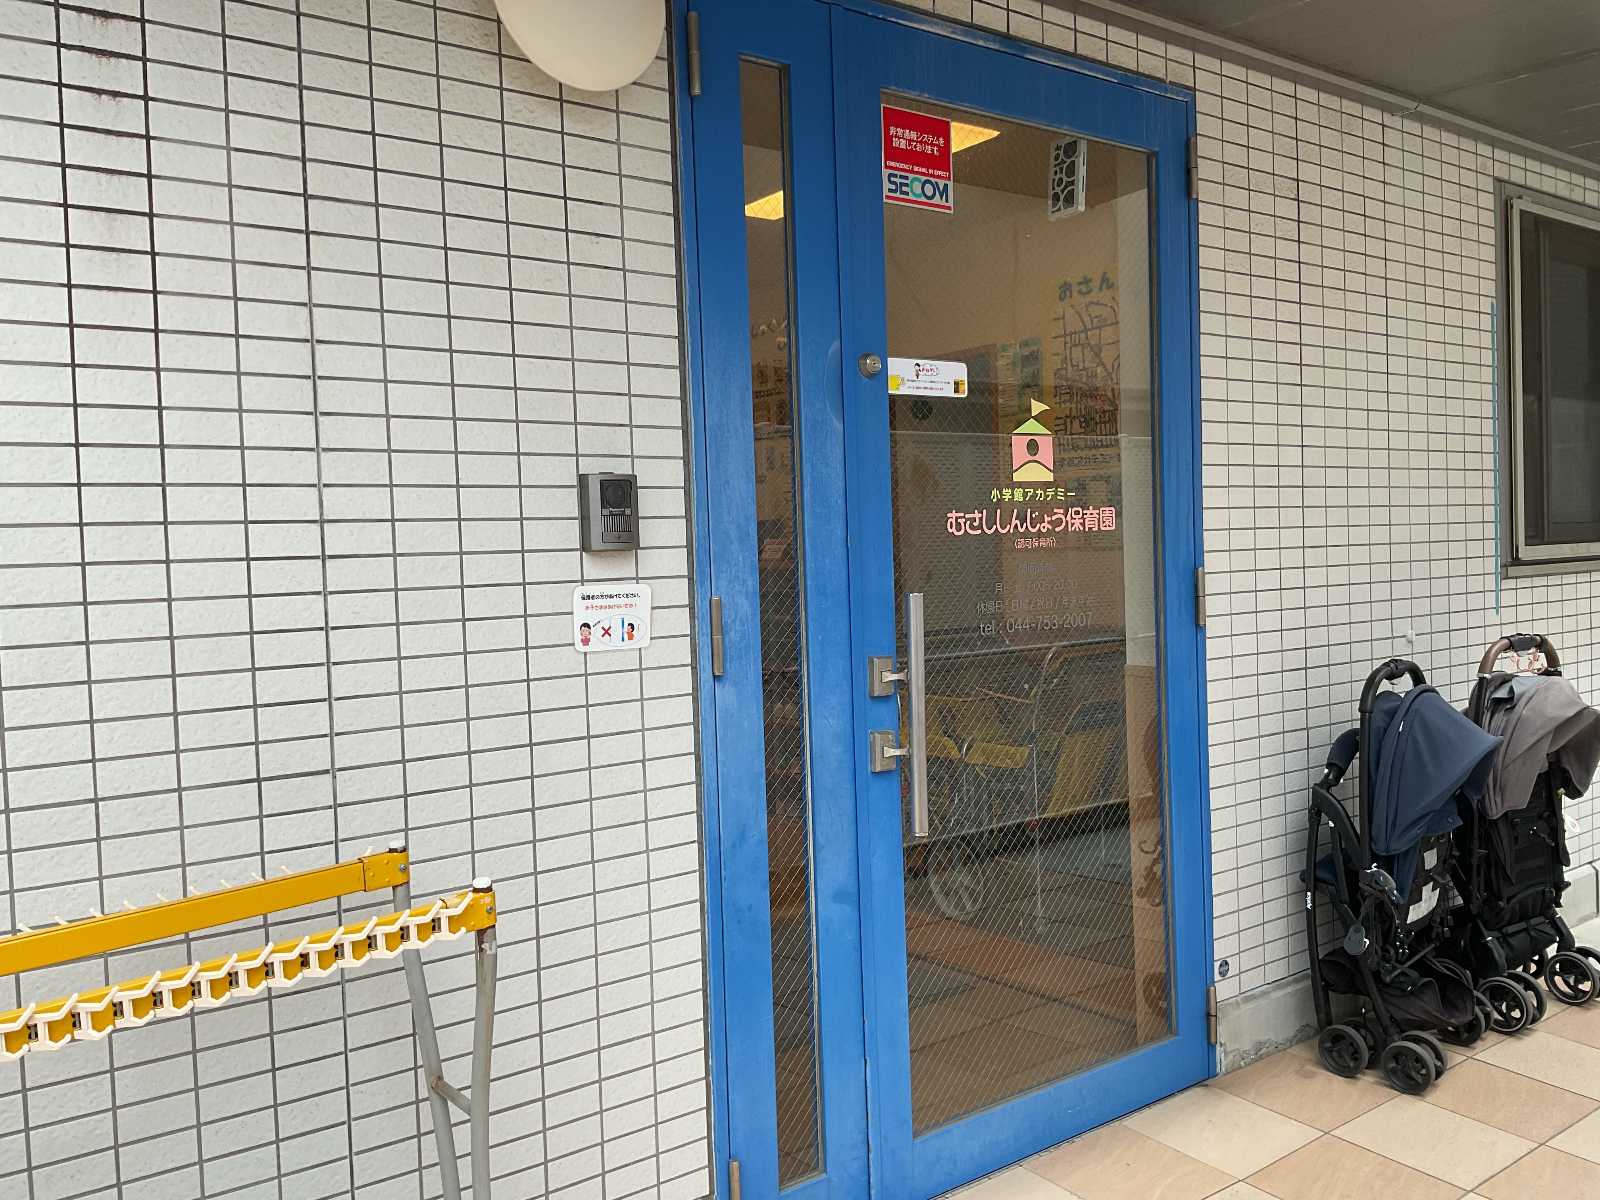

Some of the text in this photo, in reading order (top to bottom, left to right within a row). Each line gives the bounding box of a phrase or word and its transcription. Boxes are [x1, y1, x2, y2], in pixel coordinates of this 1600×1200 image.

[889, 126, 945, 147] 非常通報システムを
[887, 172, 949, 203] SECOM
[990, 488, 1076, 503] 小学館アカデミー
[946, 506, 1116, 536] むさししんじょう保育園
[1006, 612, 1093, 634] 044-753-2007
